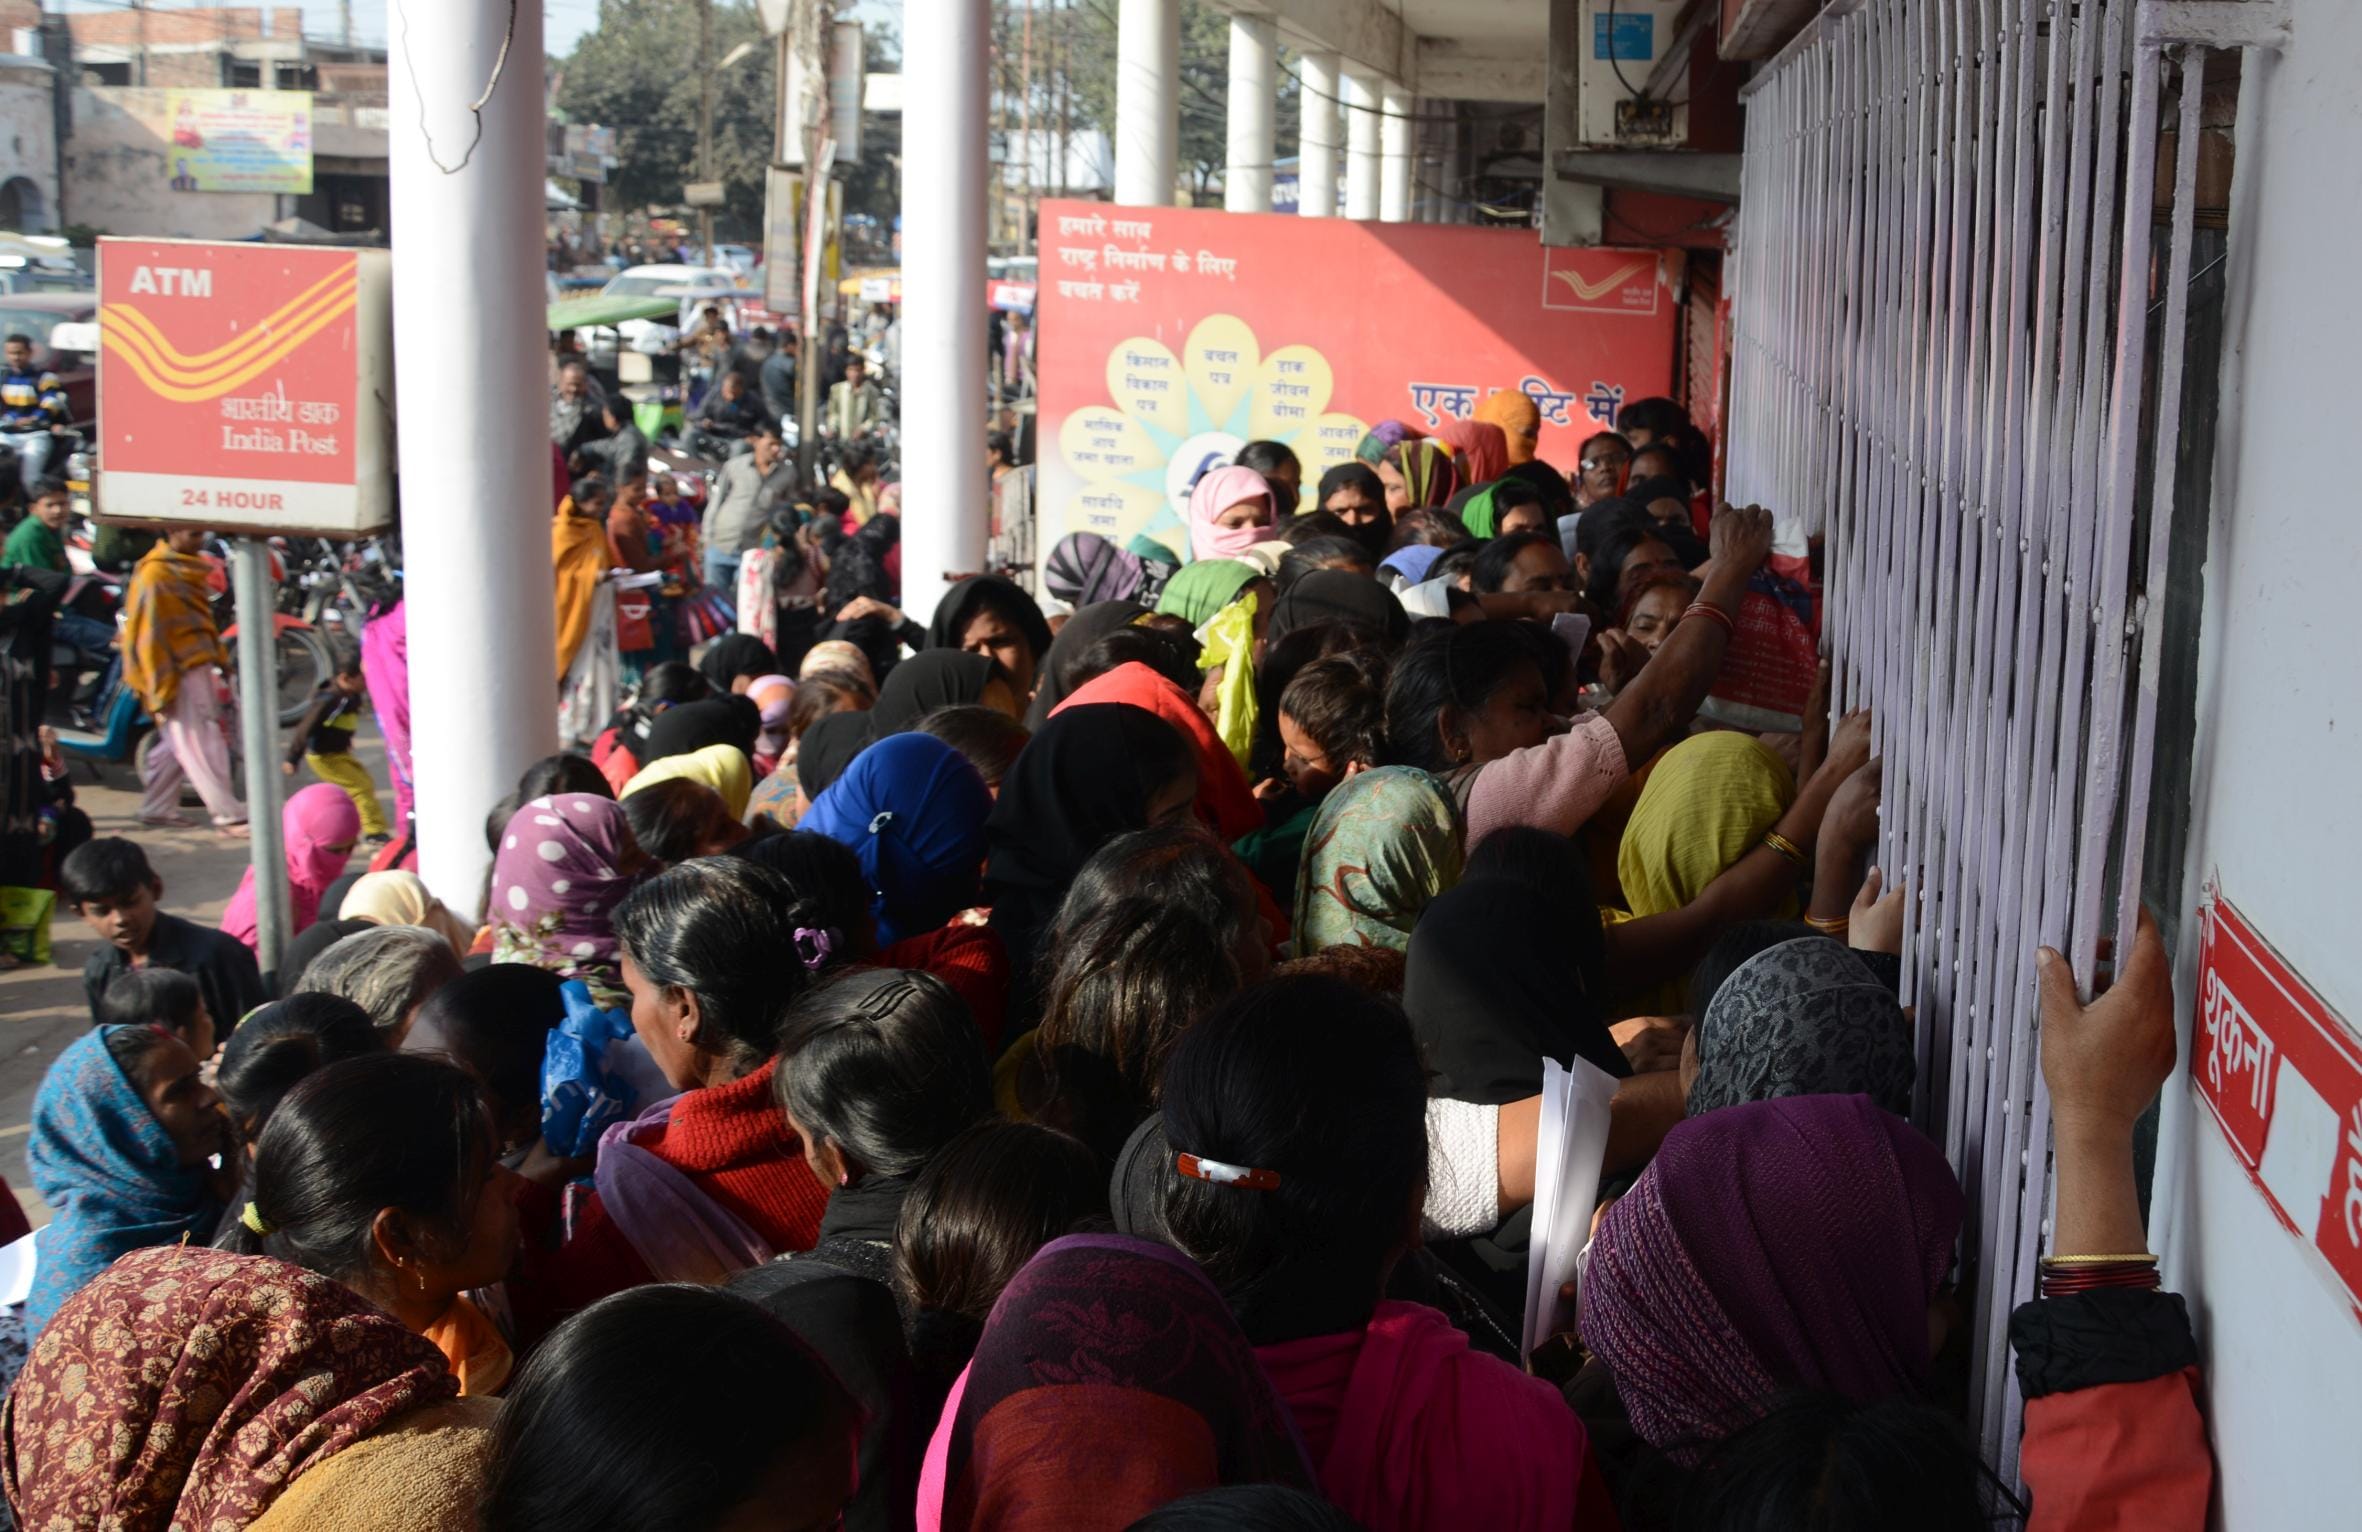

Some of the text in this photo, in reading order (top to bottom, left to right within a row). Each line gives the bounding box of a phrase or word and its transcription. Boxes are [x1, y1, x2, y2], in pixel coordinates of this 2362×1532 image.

[1057, 213, 1107, 236] हमारे
[1103, 244, 1166, 271] निर्माण
[1171, 249, 1190, 272] के
[1197, 250, 1236, 281] लिए
[129, 266, 212, 297] ATM
[1057, 278, 1141, 303] बचत करें
[221, 391, 339, 425] भारतीय डाक
[1409, 383, 1477, 426] एक
[1585, 380, 1623, 429] में
[221, 425, 339, 455] India Post
[181, 489, 284, 510] 24 HOUR
[2204, 966, 2274, 1120] थूकना
